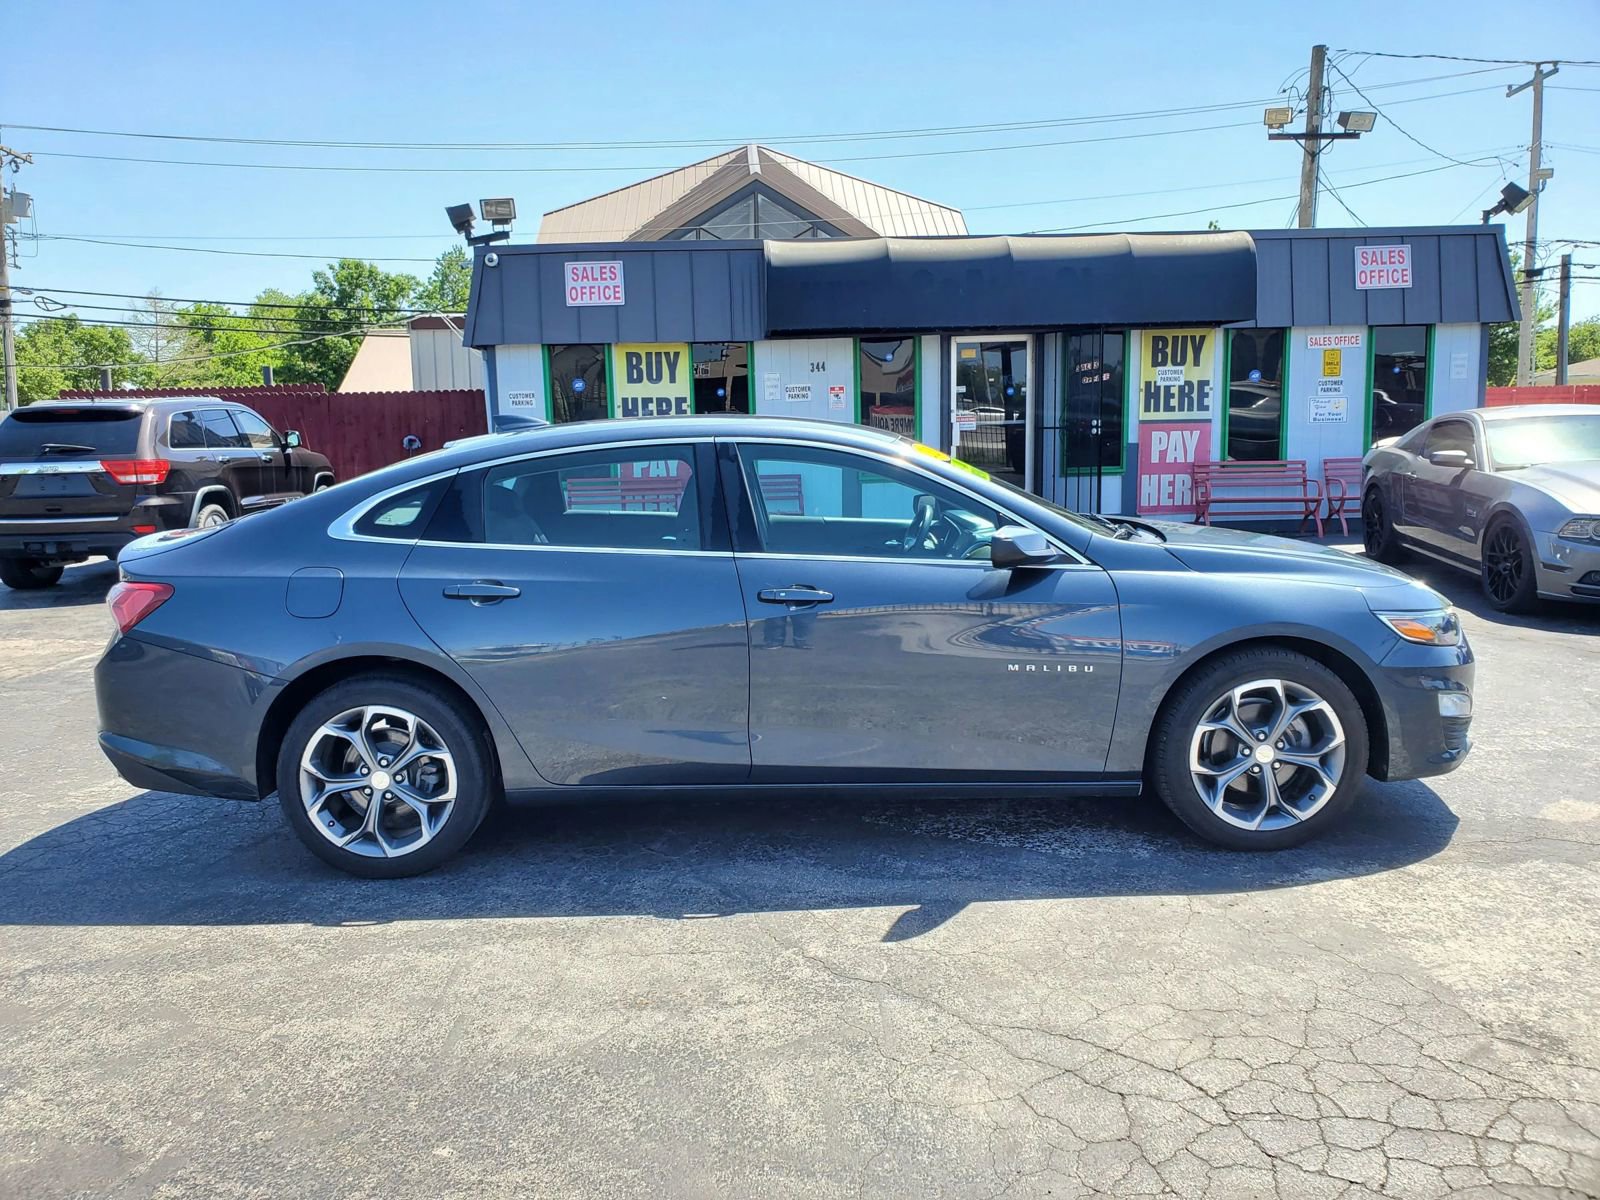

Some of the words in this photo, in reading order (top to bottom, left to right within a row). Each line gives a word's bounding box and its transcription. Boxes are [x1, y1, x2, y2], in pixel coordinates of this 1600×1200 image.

[1361, 249, 1405, 266] SALES
[571, 265, 617, 282] SALES
[1359, 268, 1409, 285] OFFICE
[569, 285, 621, 302] OFFICE
[1309, 336, 1332, 347] SALES
[1334, 335, 1360, 346] OFFICE
[1151, 334, 1207, 368] BUY
[625, 351, 681, 385] BUY
[810, 361, 826, 373] 344
[1318, 379, 1344, 387] CUSTOMER
[509, 392, 535, 400] CUSTOMER
[511, 399, 534, 407] PARKING
[1143, 380, 1210, 413] HERE
[621, 396, 688, 418] HERE
[1151, 430, 1201, 464] PAY
[1007, 663, 1094, 673] MALIBU
